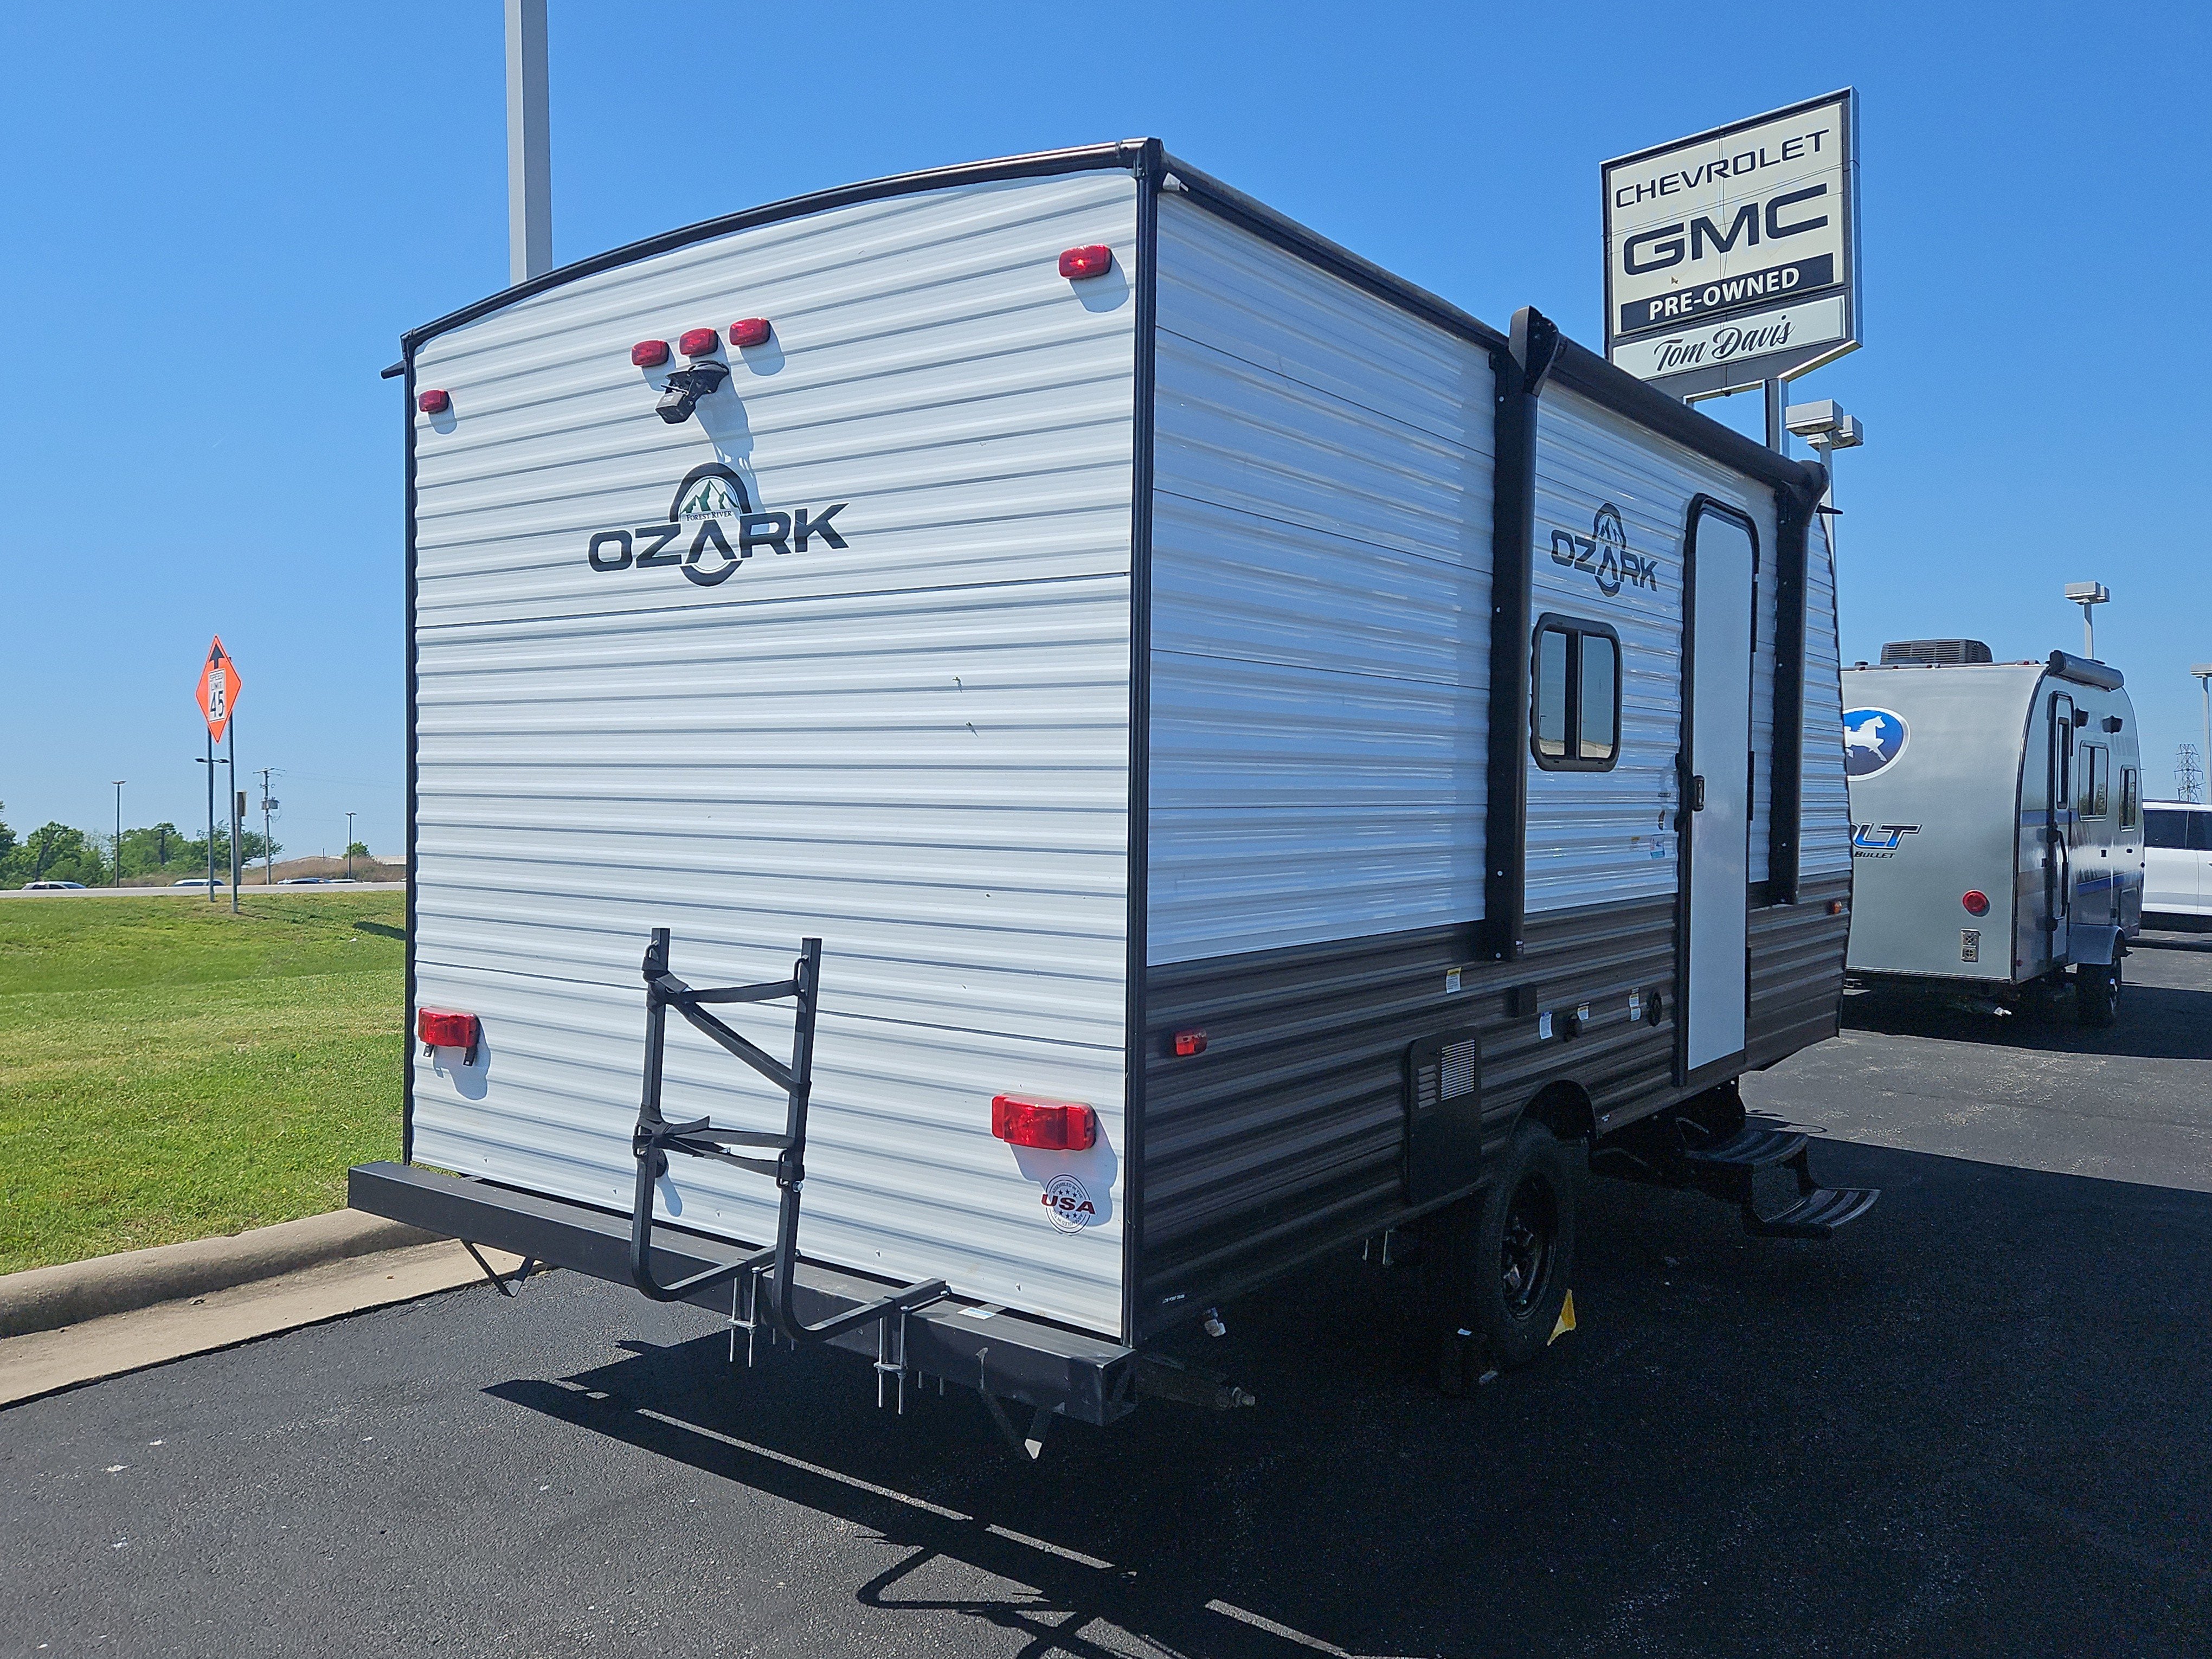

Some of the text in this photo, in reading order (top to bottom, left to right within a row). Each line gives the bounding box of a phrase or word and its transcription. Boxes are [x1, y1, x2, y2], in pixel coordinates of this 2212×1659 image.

[1616, 128, 1830, 208] CHEVROLET
[1623, 183, 1829, 275] GMC
[1649, 268, 1799, 321] PRE-OWNED
[1654, 314, 1796, 372] Tom Davis
[588, 503, 850, 573] OZARK
[686, 513, 711, 521] FOREST
[1551, 529, 1658, 593] OZARK
[210, 690, 224, 718] 45
[1041, 1194, 1096, 1215] USA
